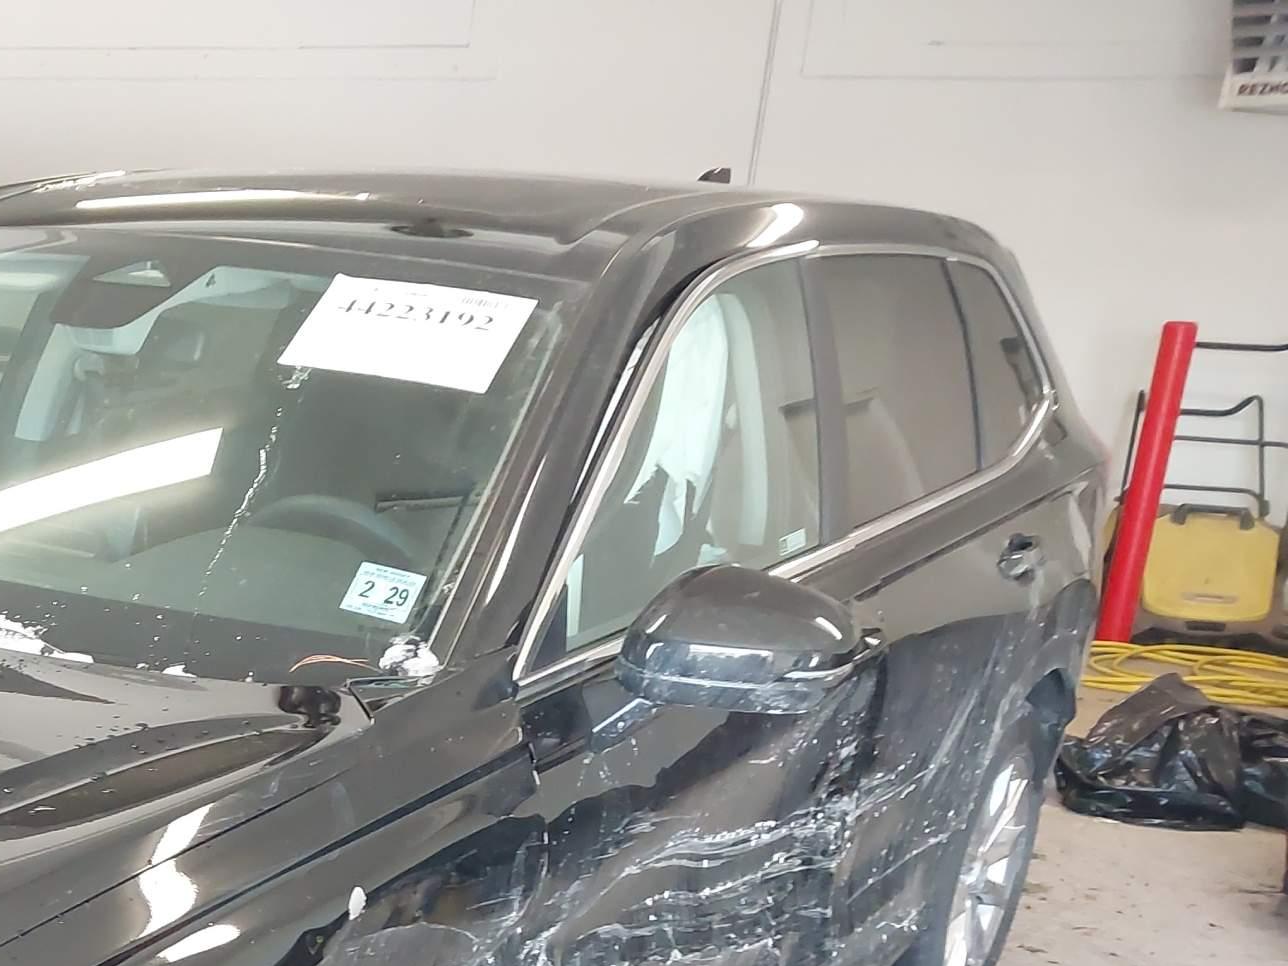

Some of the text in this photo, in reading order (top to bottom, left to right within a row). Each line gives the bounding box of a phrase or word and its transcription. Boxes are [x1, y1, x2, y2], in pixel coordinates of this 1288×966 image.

[337, 299, 494, 331] 44223192
[358, 580, 375, 598] 2
[383, 586, 409, 607] 29
